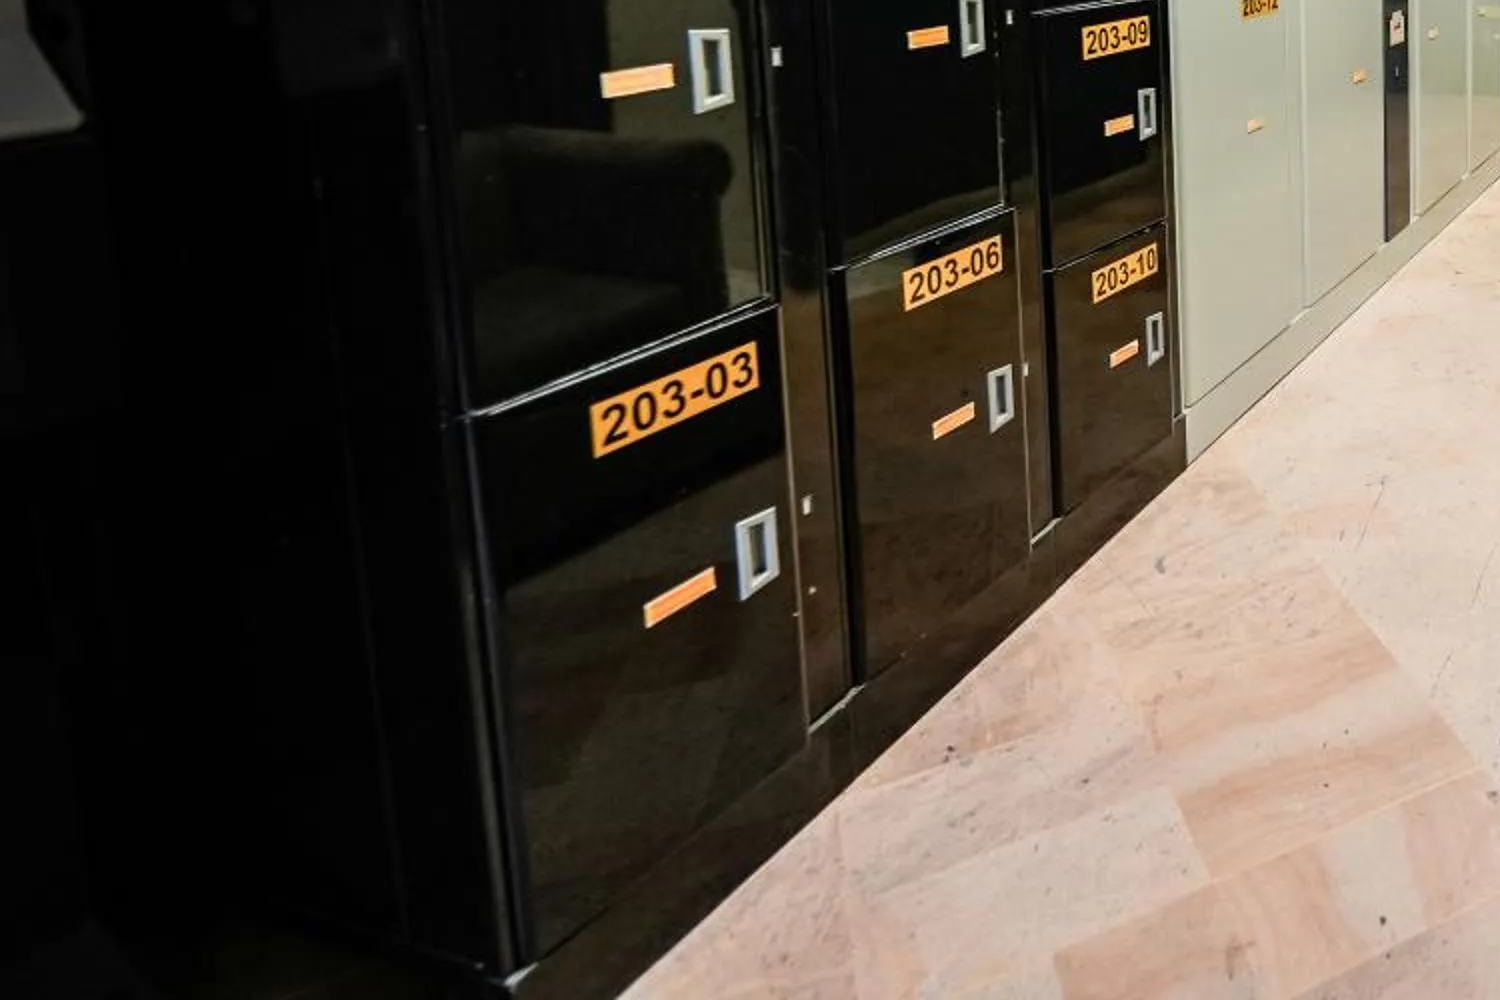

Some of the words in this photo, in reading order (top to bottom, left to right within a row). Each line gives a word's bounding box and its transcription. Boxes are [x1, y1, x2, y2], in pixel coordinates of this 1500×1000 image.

[1085, 20, 1149, 54] 203-09
[908, 240, 1000, 304] 203-06
[1095, 249, 1157, 297] 203-10
[601, 350, 754, 446] 203-03
